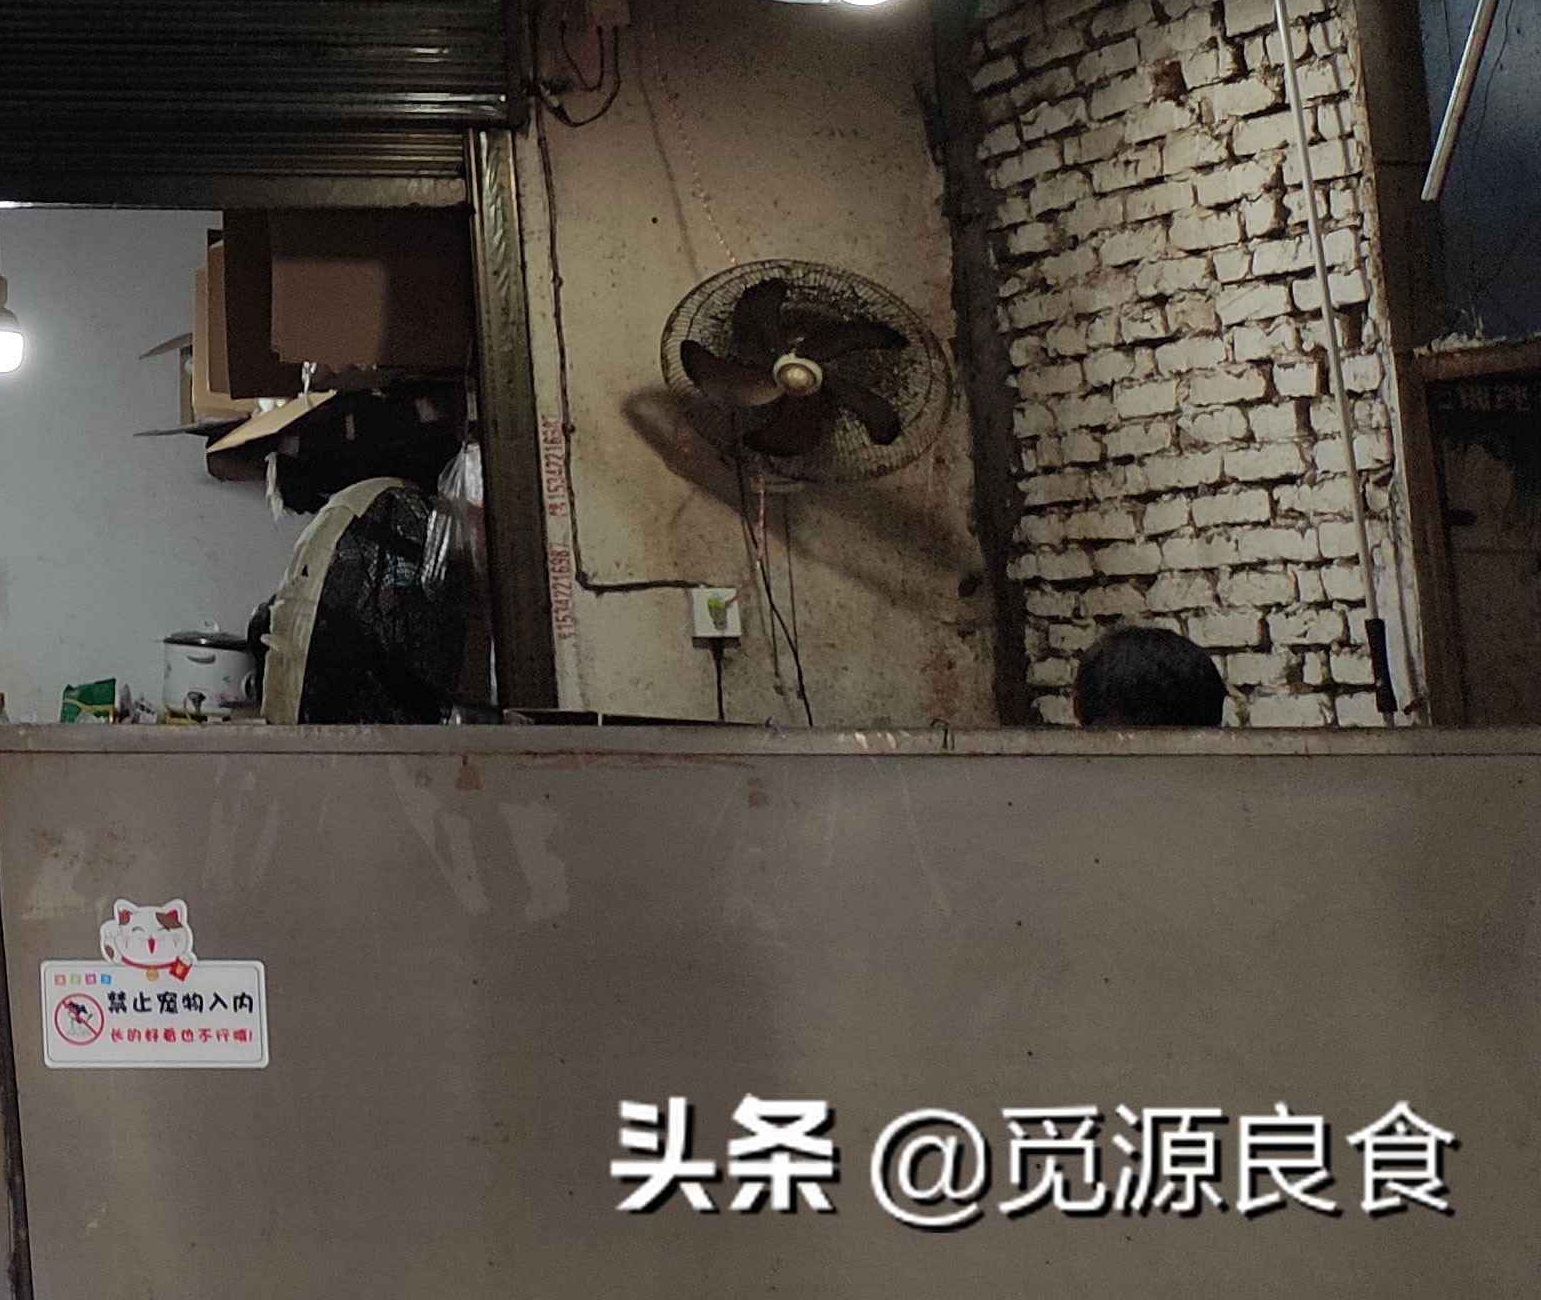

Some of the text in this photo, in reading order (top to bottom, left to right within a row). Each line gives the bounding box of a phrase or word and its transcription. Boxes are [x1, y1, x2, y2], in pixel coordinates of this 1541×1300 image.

[107, 991, 254, 1014] 禁止宠物入内
